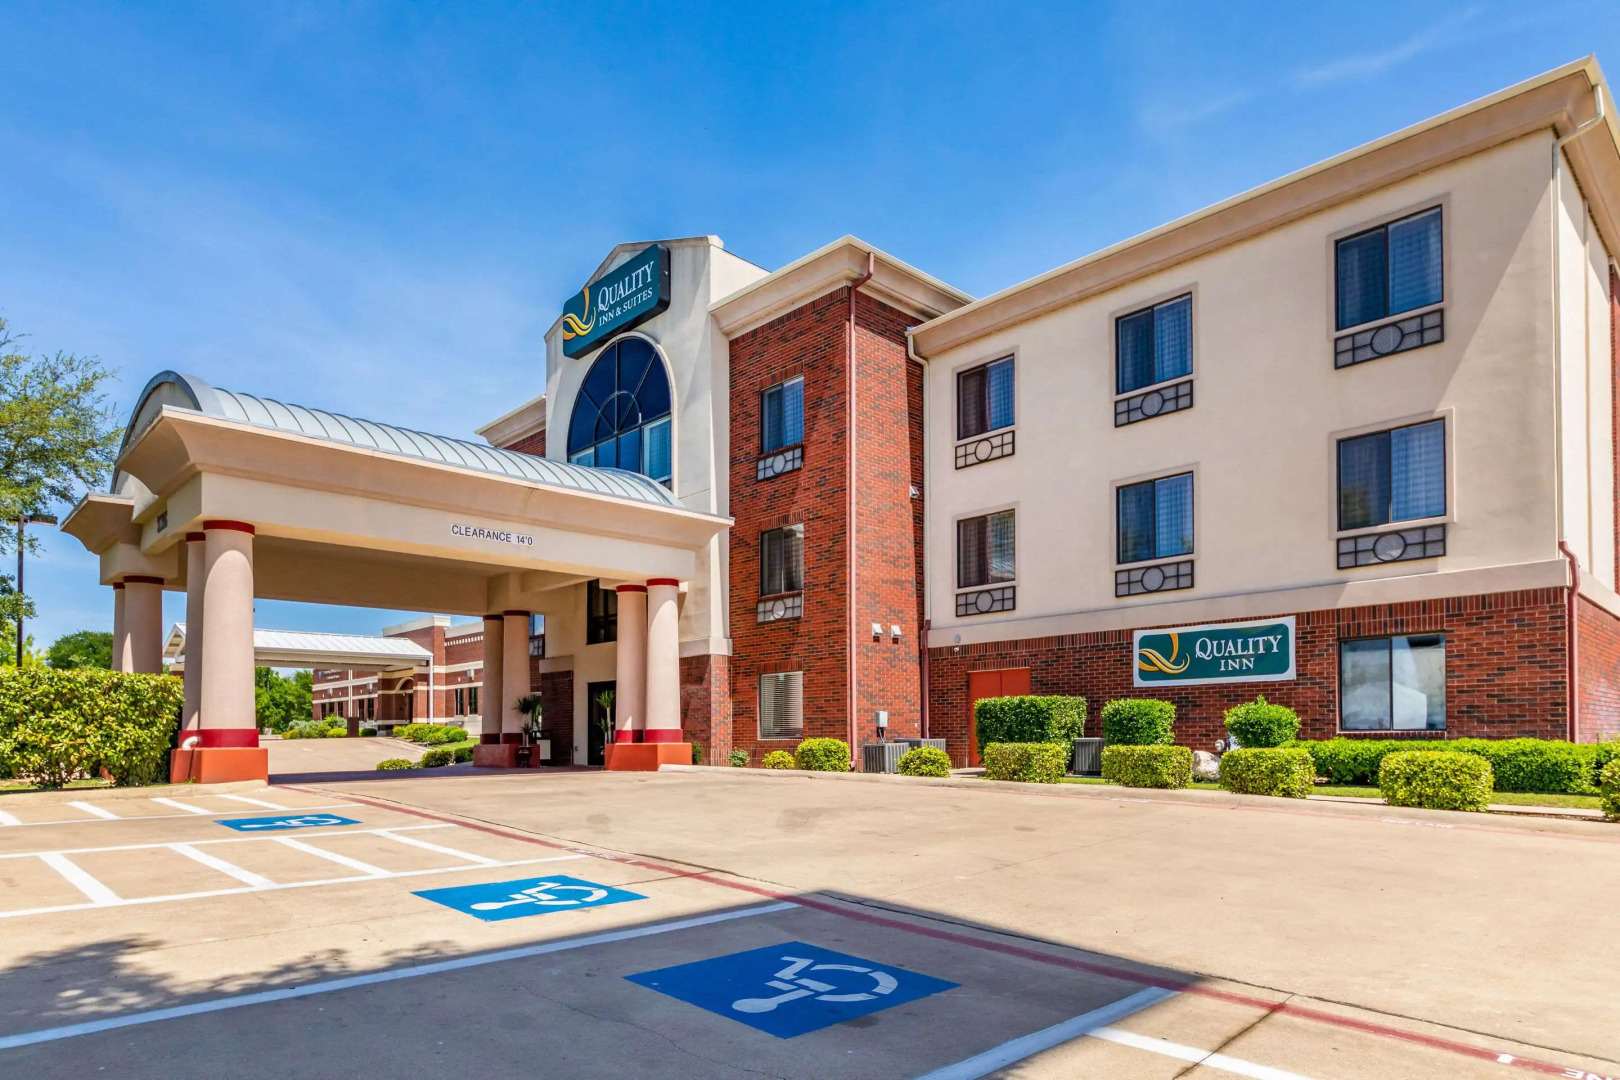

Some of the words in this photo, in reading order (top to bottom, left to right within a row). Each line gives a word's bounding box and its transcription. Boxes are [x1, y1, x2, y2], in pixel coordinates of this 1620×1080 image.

[598, 261, 654, 312] QUALITY
[598, 310, 615, 327] INN
[615, 306, 622, 315] &
[623, 287, 653, 312] SUITES
[451, 524, 512, 543] CLEARANCE
[1195, 635, 1282, 660] QUALITY
[1219, 658, 1255, 672] INN
